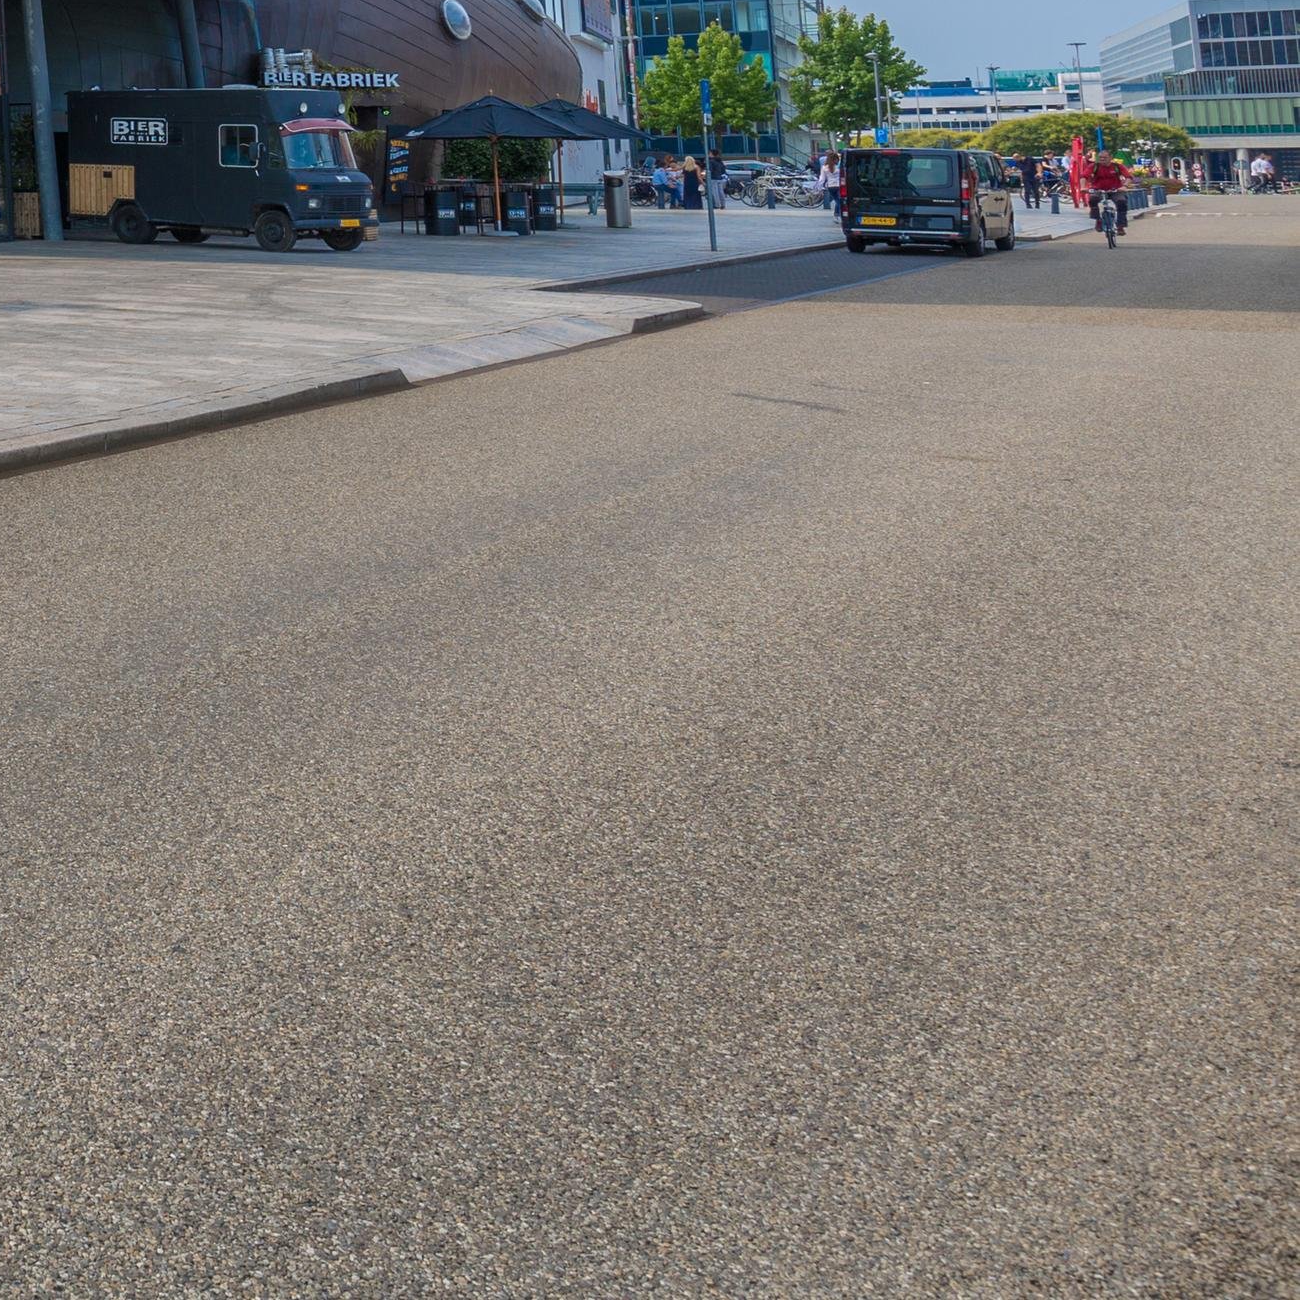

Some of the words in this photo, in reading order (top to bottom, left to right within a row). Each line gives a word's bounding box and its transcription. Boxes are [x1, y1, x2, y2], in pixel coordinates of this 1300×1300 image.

[264, 72, 306, 86] BIER
[311, 73, 400, 87] FABRIEK
[113, 120, 166, 136] BIER
